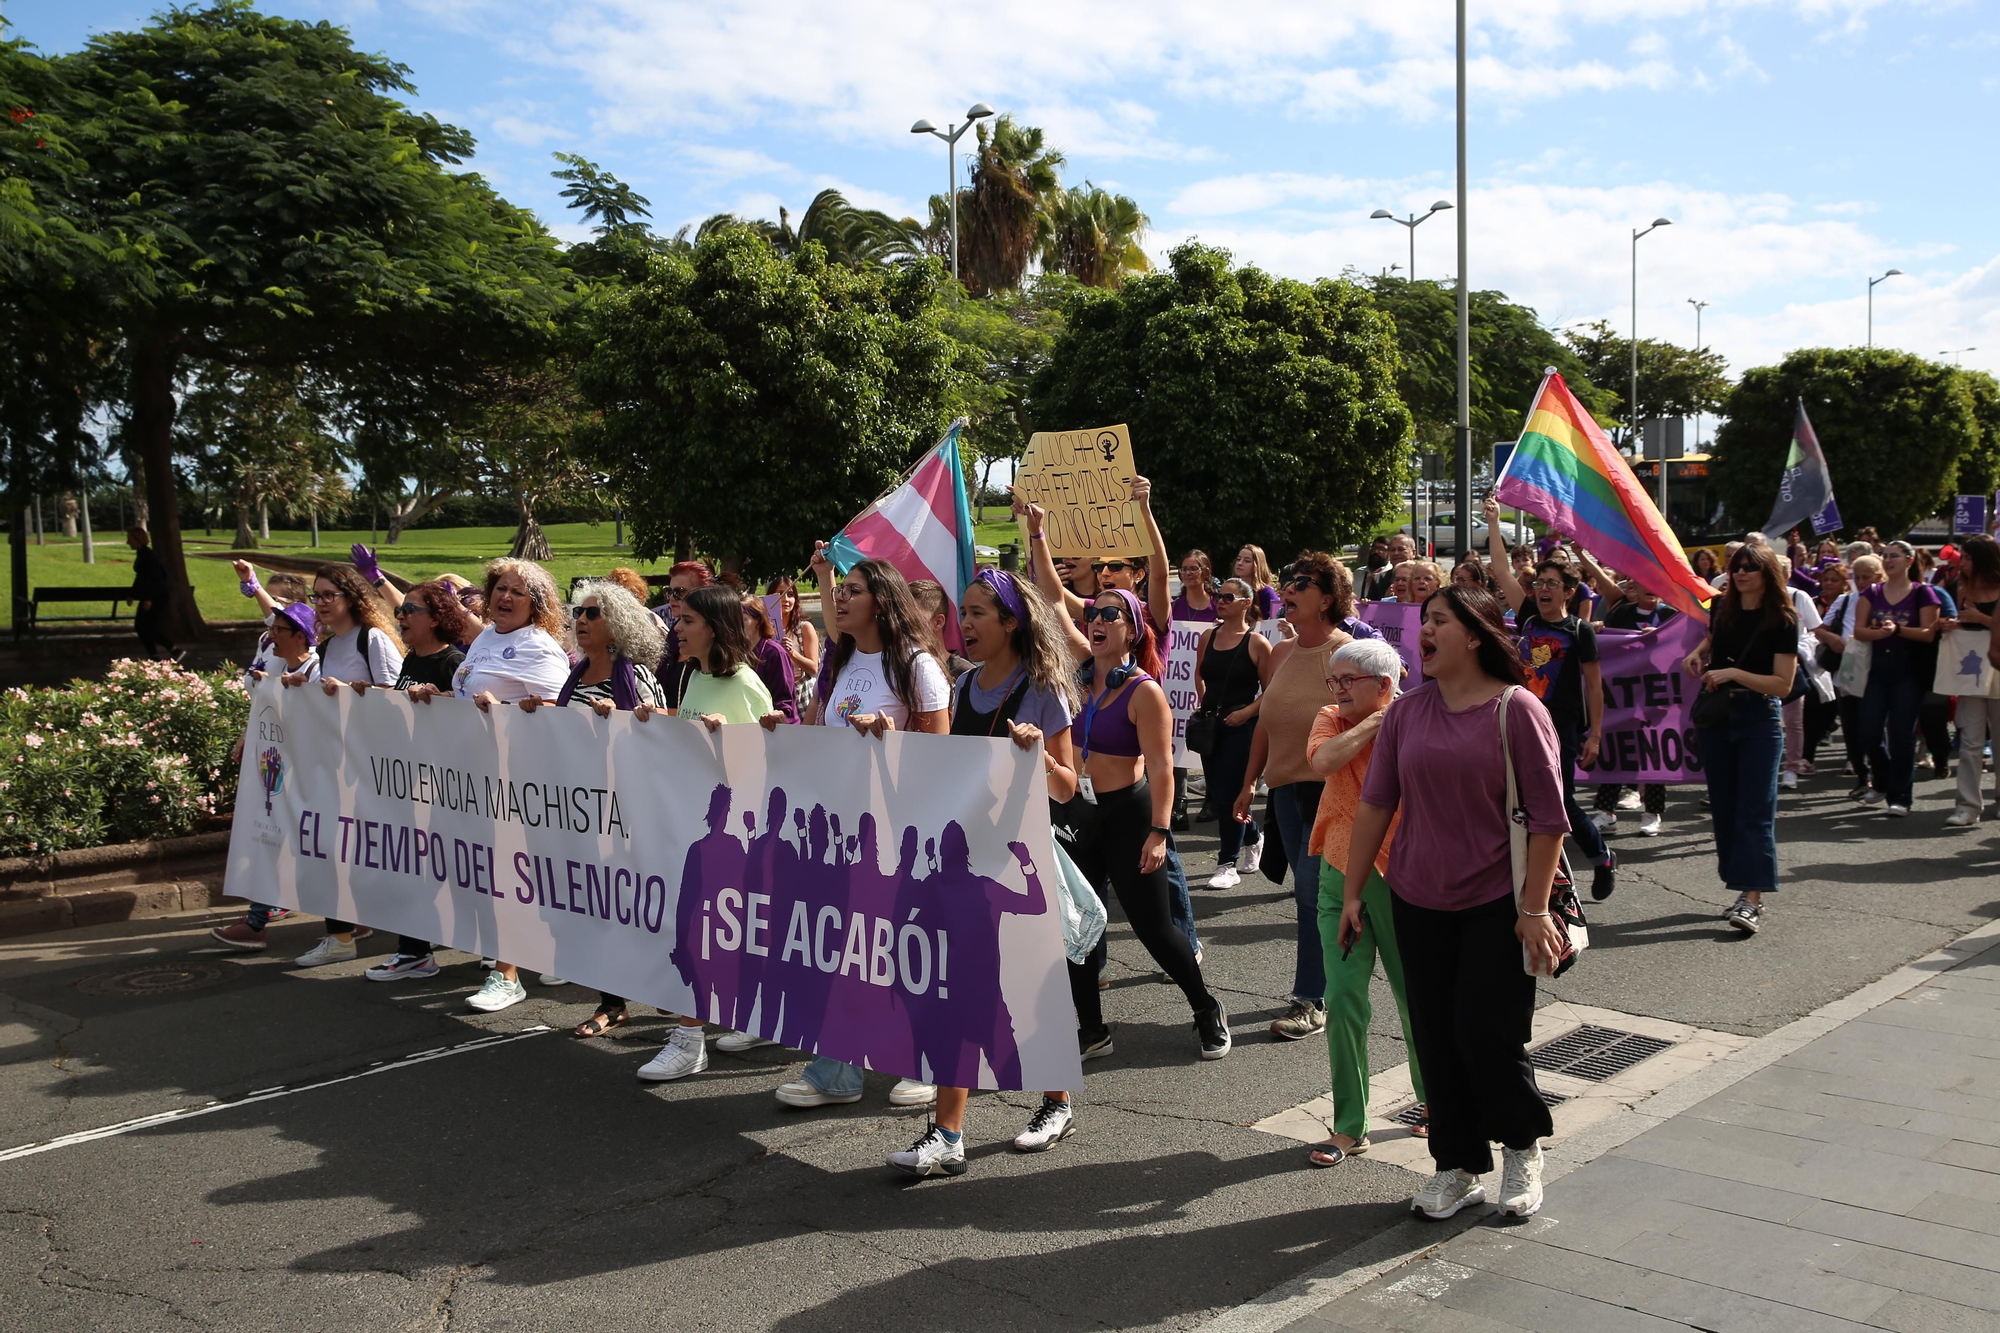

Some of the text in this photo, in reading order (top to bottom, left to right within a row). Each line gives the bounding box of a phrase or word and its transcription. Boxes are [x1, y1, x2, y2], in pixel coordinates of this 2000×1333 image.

[1041, 432, 1097, 467] LUCHA
[1017, 468, 1052, 504] SERÁ
[1048, 496, 1143, 549] O NO SERÁ
[845, 678, 872, 693] RED
[259, 721, 284, 744] RED
[370, 756, 631, 839] VIOLENCIA MACHISTA.
[300, 810, 666, 934] EL TIEMPO DEL SILENCIO
[701, 887, 949, 1000] ¡SE ACABÓ!
